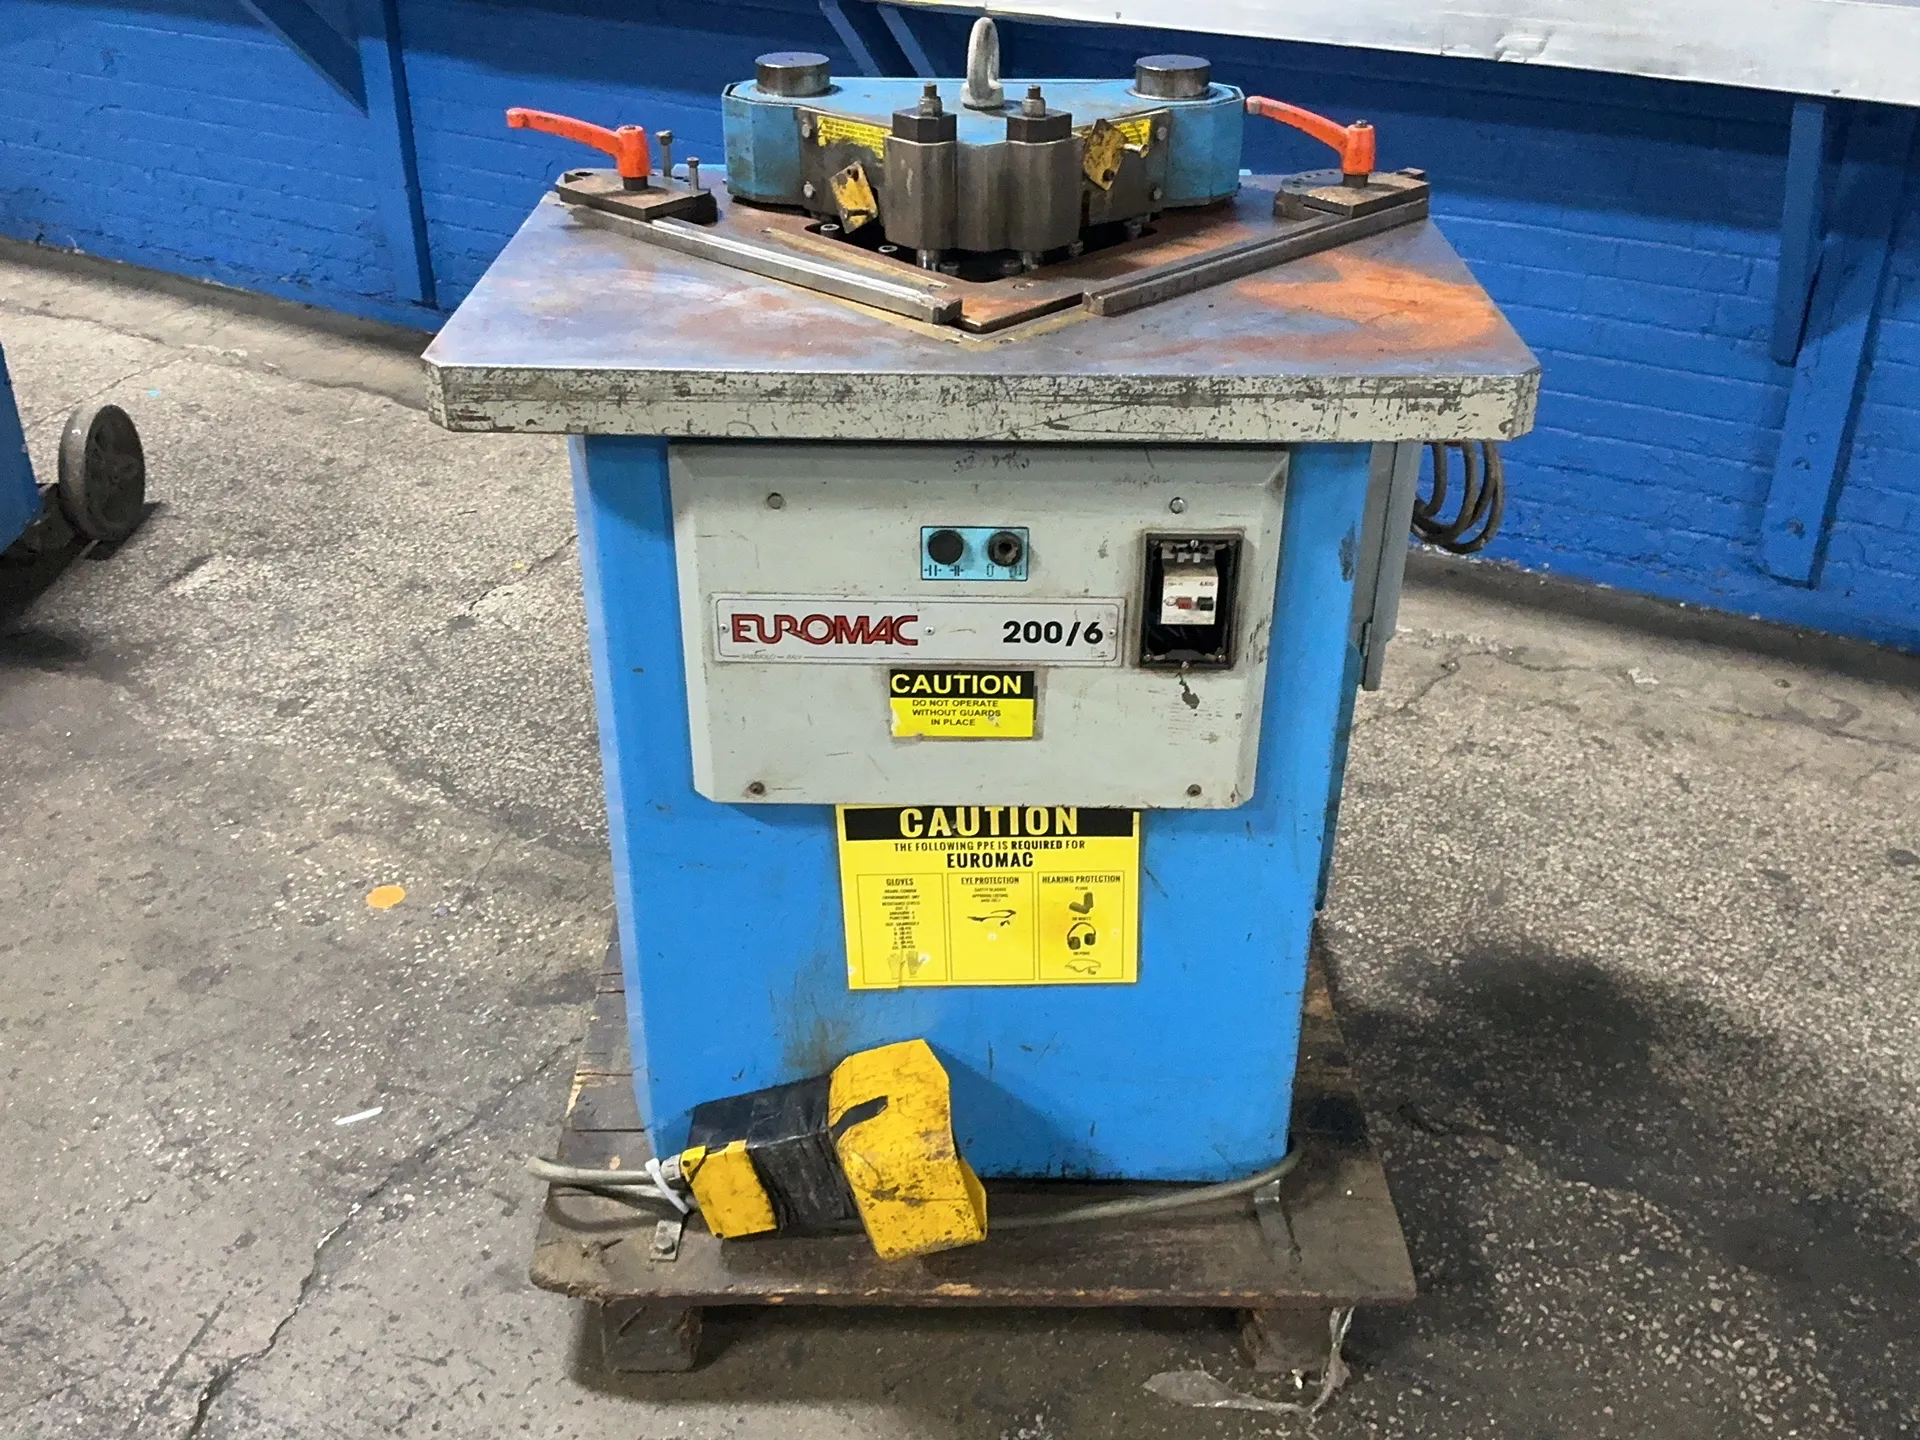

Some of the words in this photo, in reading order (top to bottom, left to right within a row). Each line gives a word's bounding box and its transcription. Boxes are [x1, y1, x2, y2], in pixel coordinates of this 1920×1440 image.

[731, 613, 918, 646] EUROMAC
[1003, 620, 1103, 647] 200/6
[891, 673, 1022, 695] CAUTION
[912, 699, 927, 707] DO
[929, 699, 949, 707] NOT
[952, 699, 999, 708] OPERATE
[912, 709, 957, 717] WITHOUT
[959, 709, 1002, 717] GUARDS
[931, 718, 941, 726] IN
[943, 718, 976, 727] PLACE
[899, 806, 1078, 838] CAUTION
[894, 842, 912, 852] THE
[915, 841, 974, 851] FOLLOWING
[977, 841, 995, 851] PPE
[998, 840, 1008, 850] IS
[1011, 840, 1062, 850] REQUIRED
[1066, 840, 1086, 849] FOR
[947, 852, 1034, 869] EUROMAC
[886, 878, 914, 887] GLOVES
[961, 877, 973, 885] EYE
[974, 876, 1020, 885] PROTECTION
[1042, 876, 1074, 884] HEARING
[1076, 875, 1121, 883] PROTECTION
